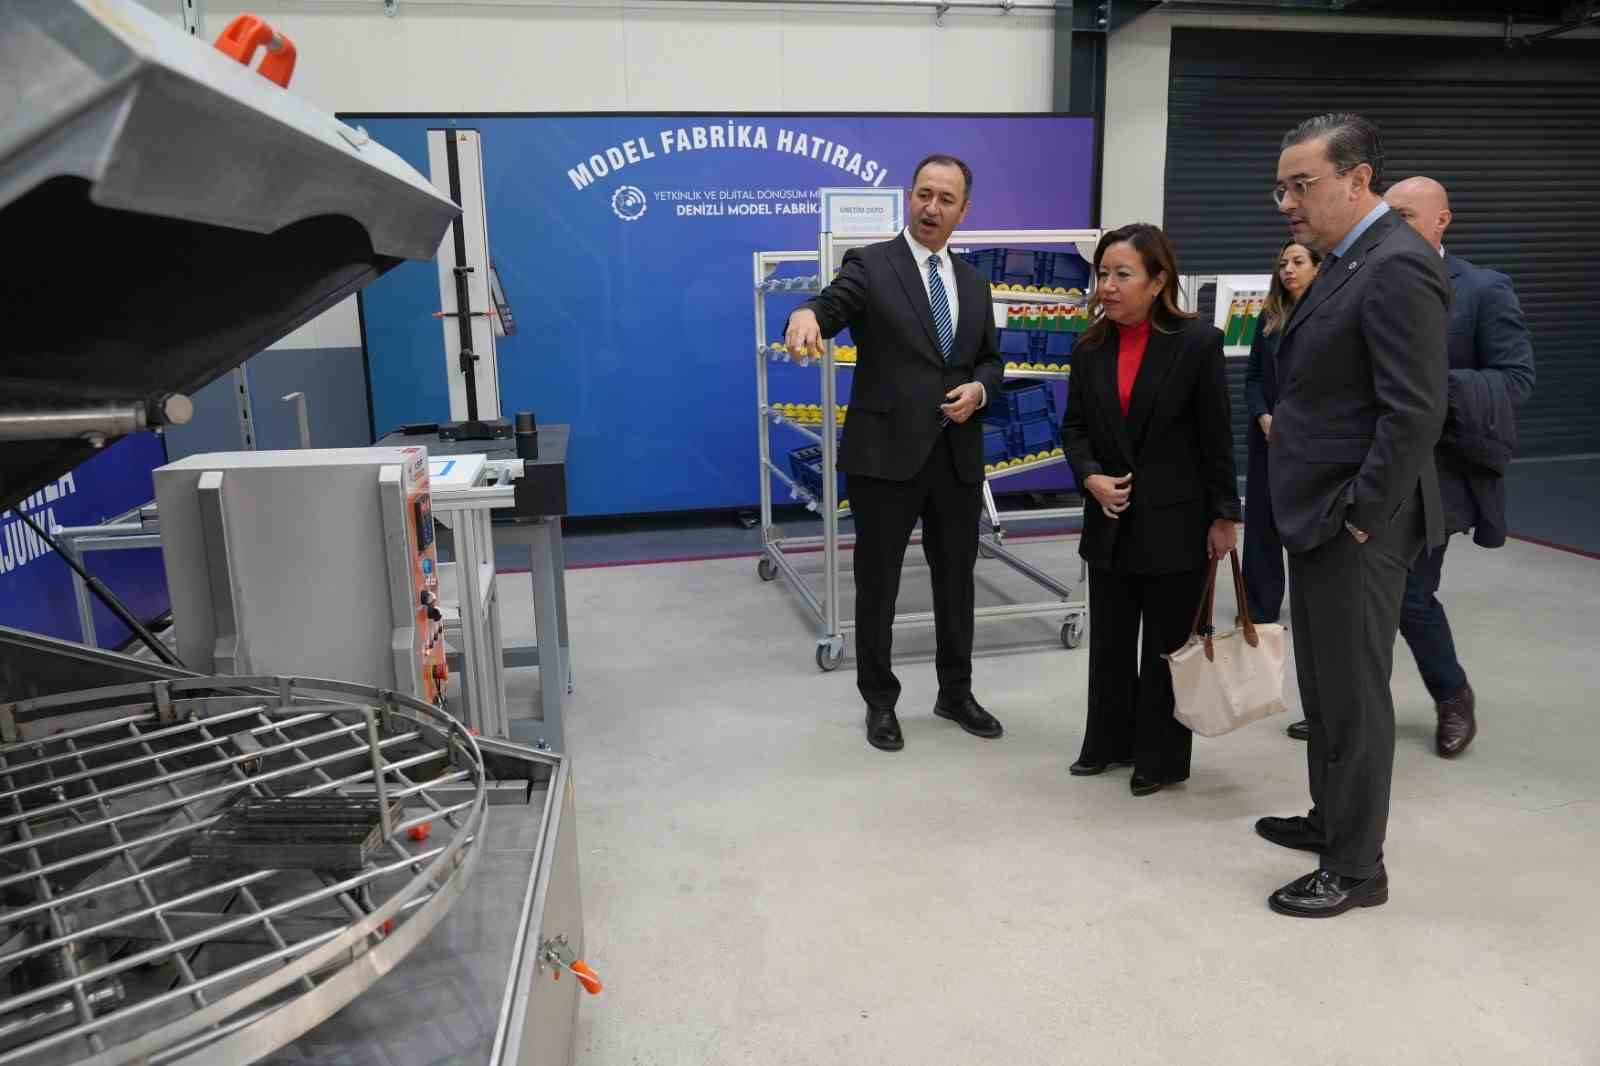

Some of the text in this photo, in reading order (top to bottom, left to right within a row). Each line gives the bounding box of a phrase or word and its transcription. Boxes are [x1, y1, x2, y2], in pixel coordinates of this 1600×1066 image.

[567, 120, 888, 191] MODEL FABRİKA HATIRASI
[704, 191, 717, 200] VE
[676, 202, 724, 216] DENİZLİ
[727, 204, 772, 215] MODEL
